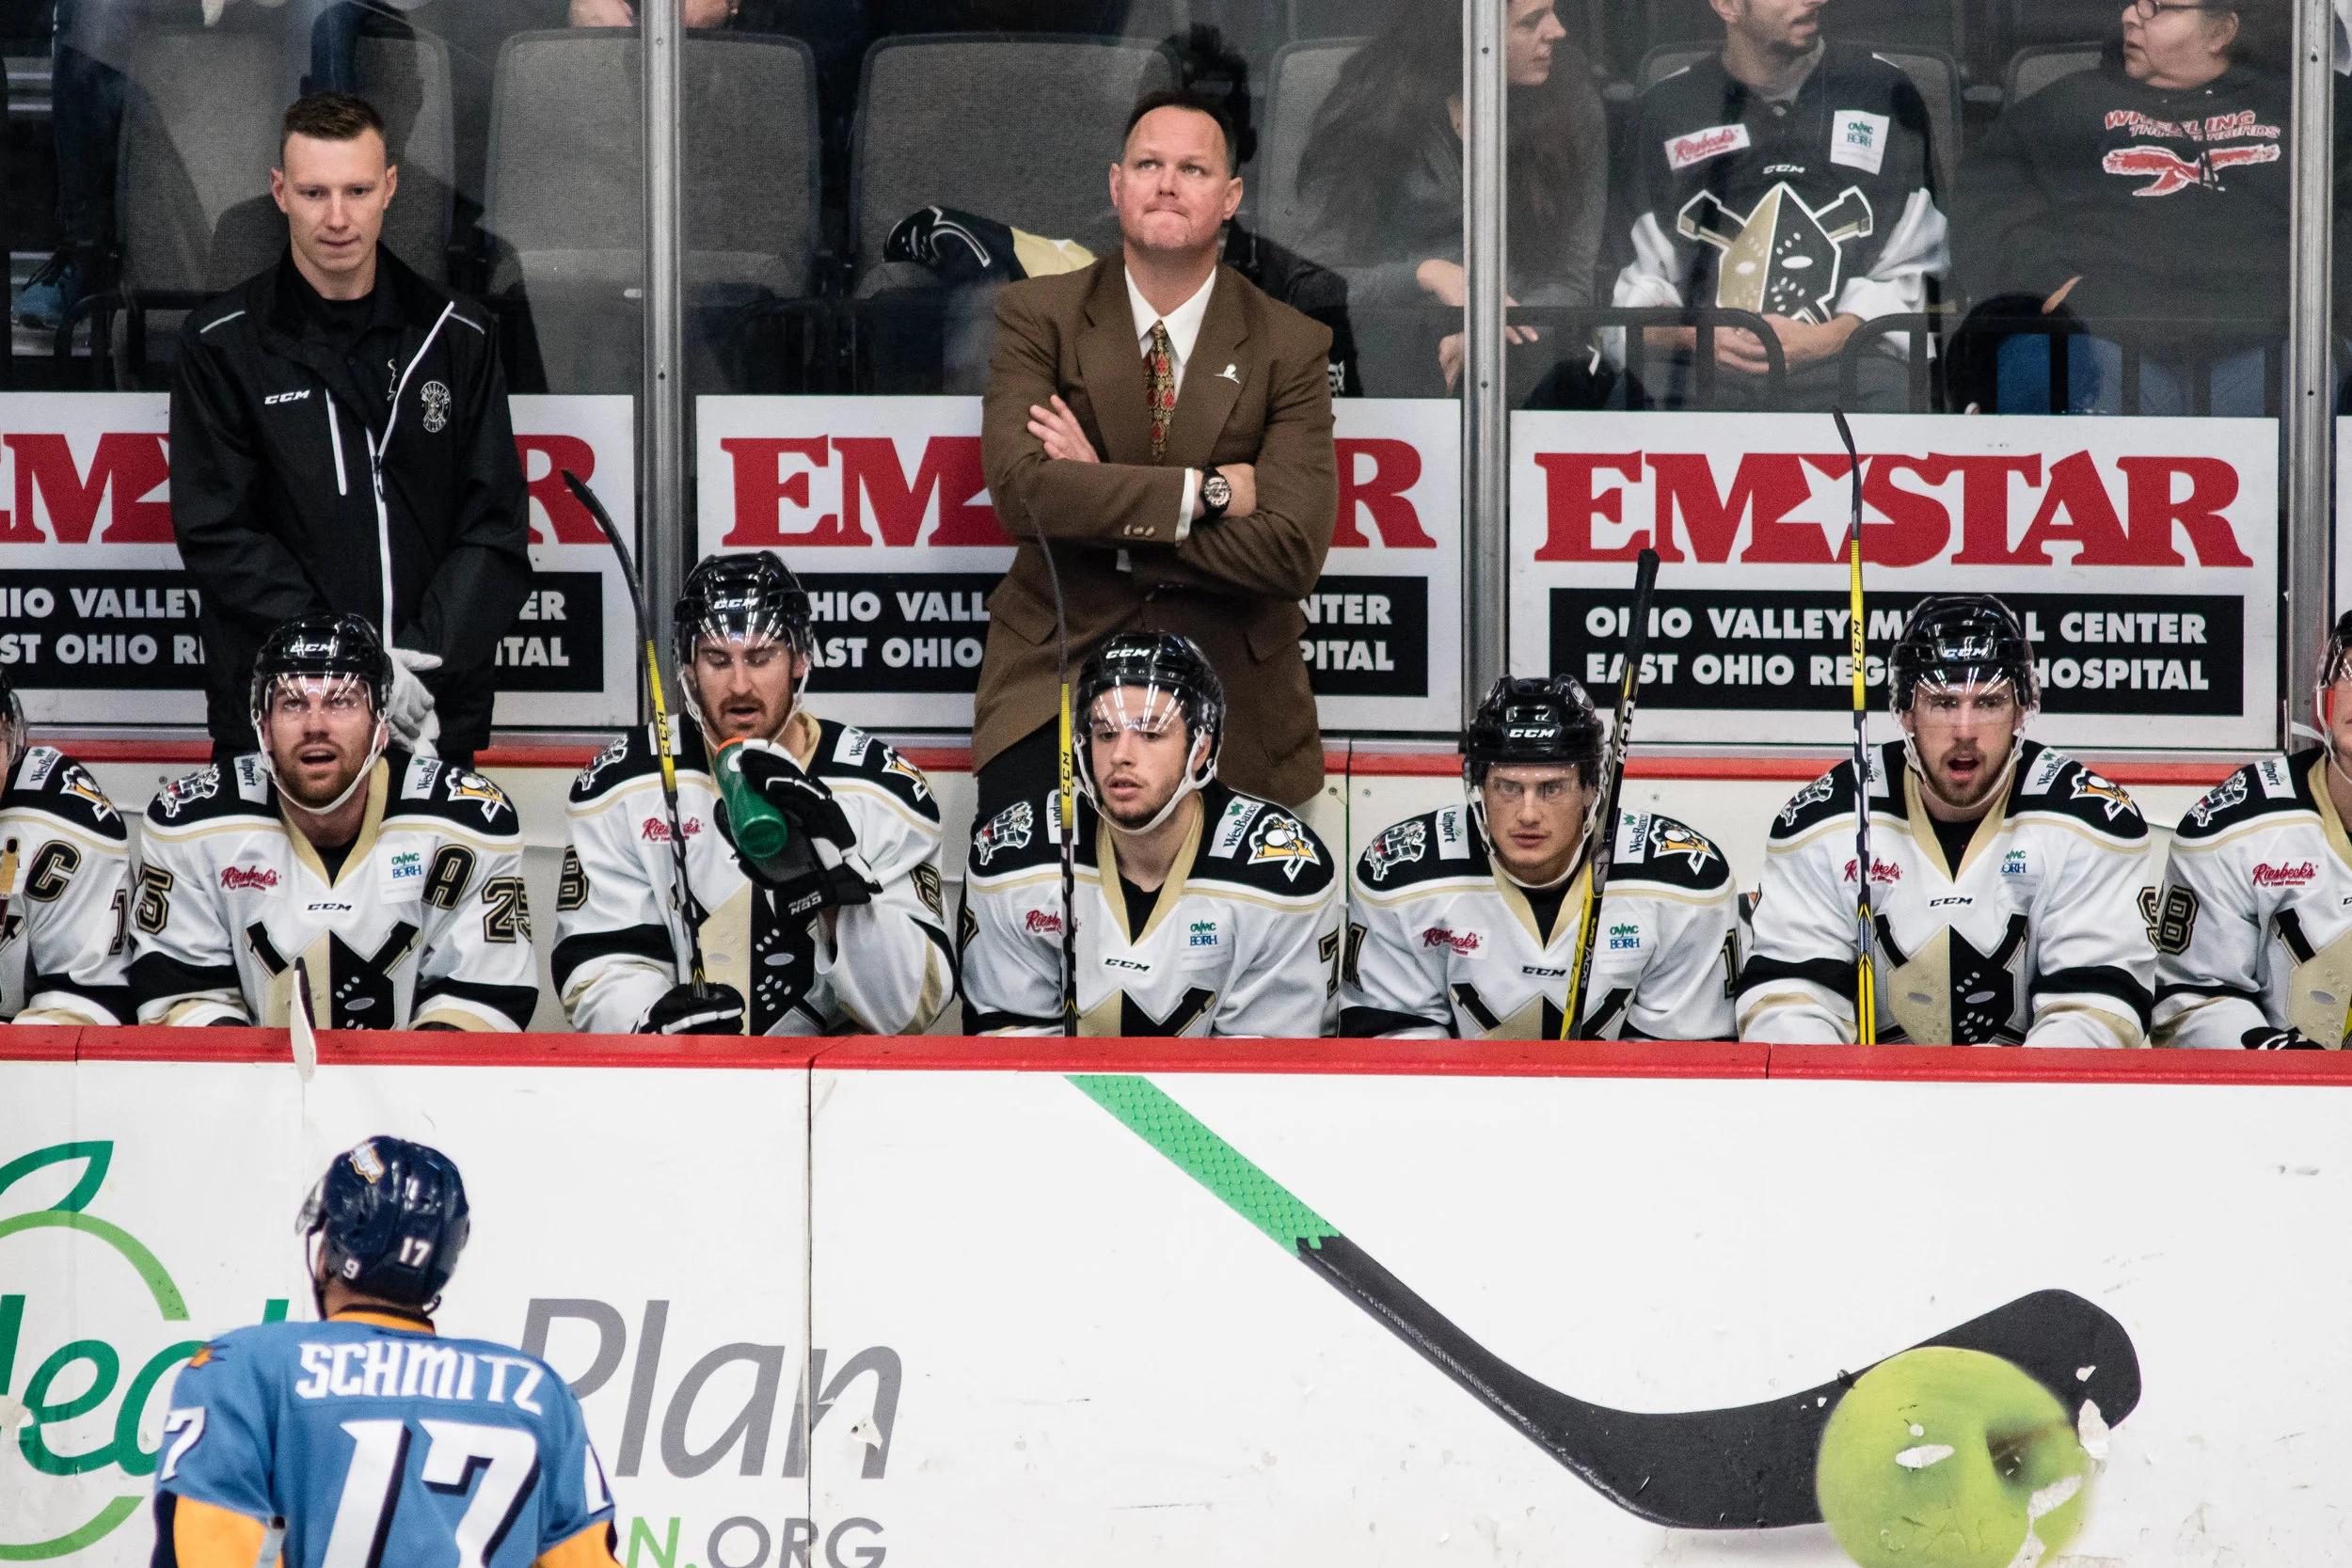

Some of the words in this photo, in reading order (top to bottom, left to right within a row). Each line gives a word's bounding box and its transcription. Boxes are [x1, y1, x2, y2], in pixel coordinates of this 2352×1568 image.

[2105, 109, 2256, 133] WHLING
[264, 388, 310, 405] CCM
[714, 597, 760, 610] CCM
[807, 591, 882, 623] HIO
[895, 591, 991, 623] VALL
[1297, 594, 1392, 626] NTER
[1707, 608, 1851, 641] VALLEY
[2059, 611, 2208, 644] CENTER
[0, 633, 41, 664] ST
[56, 633, 158, 665] OHIO
[290, 642, 336, 654] CCM
[812, 637, 868, 669] ST
[882, 637, 983, 669] OHIO
[1298, 640, 1394, 672] PITAL
[1105, 648, 1151, 659] CCM
[1852, 619, 1862, 673] CCM
[1942, 648, 1989, 657] CCM
[1692, 654, 1795, 687] OHIO
[2030, 657, 2209, 691] HOSPITAL
[657, 711, 672, 759] CCM
[849, 732, 871, 756] WesB
[1509, 728, 1556, 738] CCM
[1616, 699, 1636, 765] CCM
[1062, 752, 1071, 798] CCM
[2260, 760, 2280, 786] lfport
[1223, 803, 1259, 847] WesBanco
[24, 840, 82, 903] C
[220, 864, 279, 890] Riesbeck's
[421, 844, 477, 911] A
[1844, 858, 1900, 884] Rbeck's
[2252, 862, 2316, 887] Riesbeck's
[307, 903, 353, 911] CCM
[1930, 896, 1974, 908] CCM
[1025, 910, 1078, 932] Riesb
[1104, 958, 1151, 973] CCM
[1521, 965, 1566, 977] CCM
[1581, 945, 1594, 990] TACKS
[399, 1236, 432, 1267] 17
[342, 1258, 360, 1280] 9
[294, 1340, 546, 1417] SCHMITZ
[519, 1298, 902, 1480] Plan
[321, 1418, 543, 1568] 17
[627, 1516, 887, 1568] N.ORG
